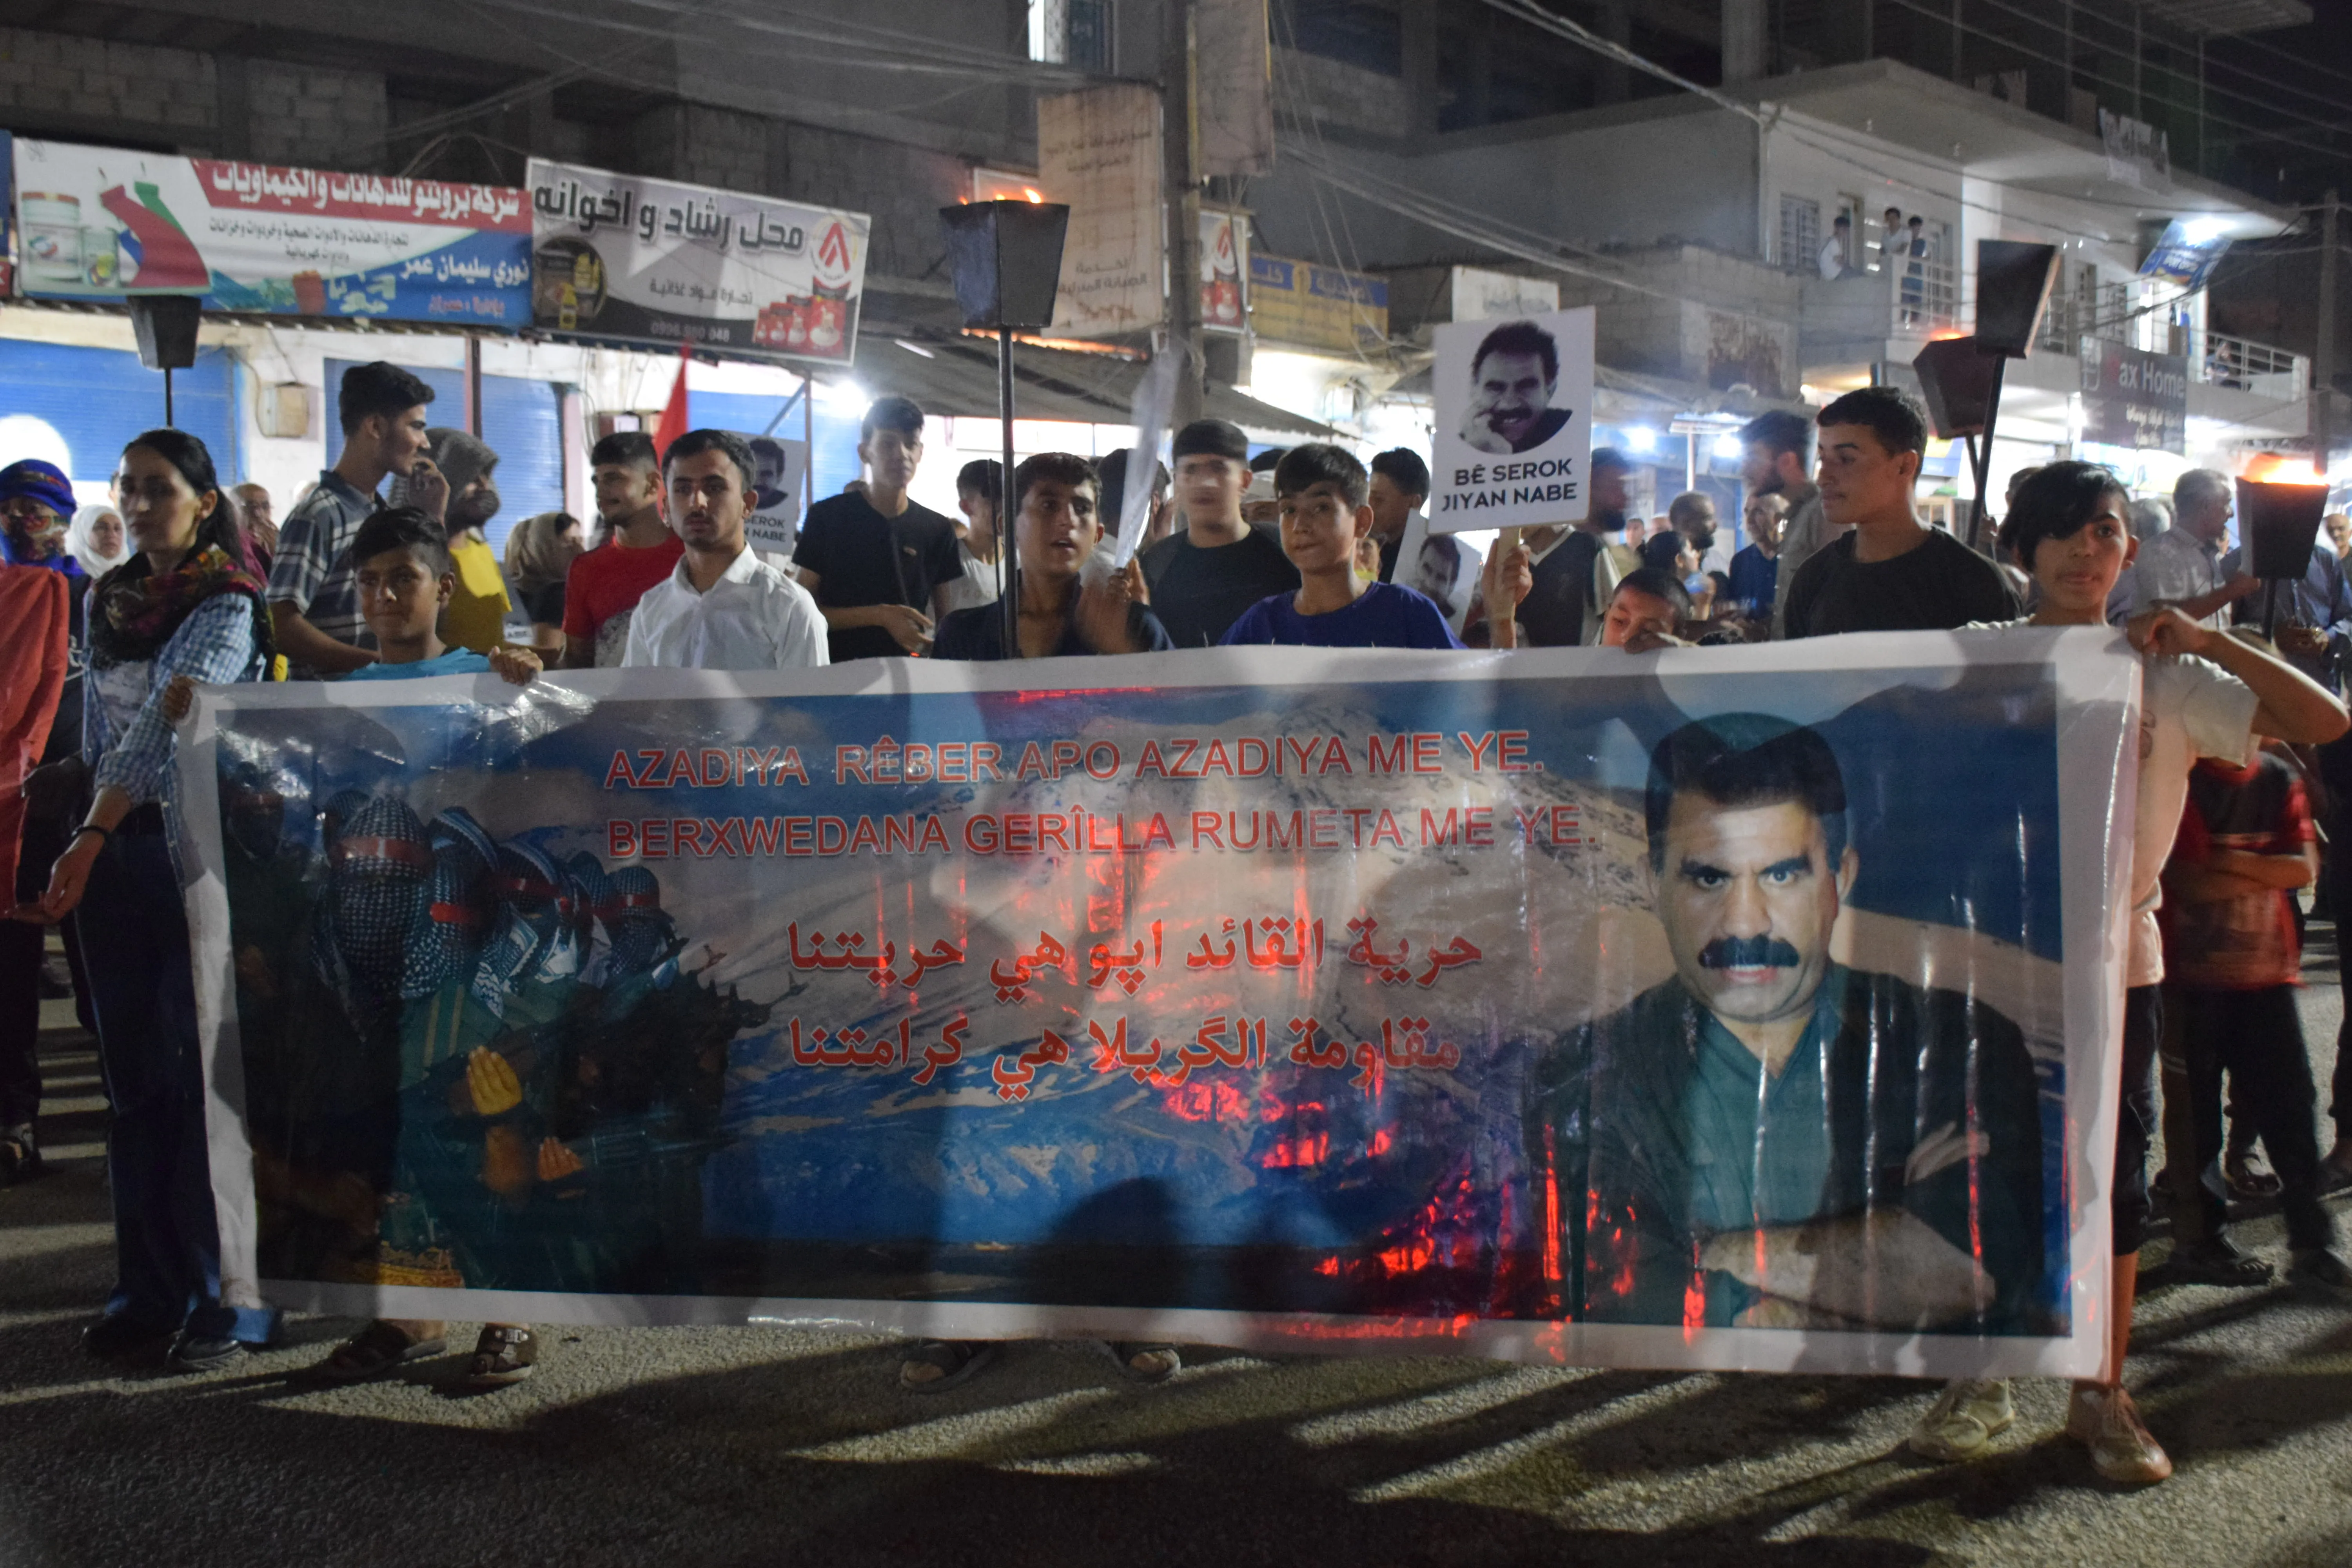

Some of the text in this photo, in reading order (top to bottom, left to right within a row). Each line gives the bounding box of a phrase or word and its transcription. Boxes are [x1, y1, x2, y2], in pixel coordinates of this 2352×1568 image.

[212, 162, 328, 209] والكيماويات
[331, 172, 412, 207] للدهانات
[472, 183, 519, 224] شركة
[534, 182, 804, 250] محل رشاد و اخوانه
[400, 257, 433, 280] عمر
[437, 254, 491, 284] سليمان
[2142, 359, 2185, 398] Home
[1441, 483, 1577, 512] JIYAN NABE
[1455, 458, 1572, 486] BÊ SEROK
[753, 528, 786, 542] NABE
[605, 730, 1544, 788] AZADIYA RÊBER APO AZADIYA ME YE.
[608, 813, 951, 858] BERXWEDANA
[964, 804, 1176, 855] GERÎLLA
[1191, 808, 1404, 851] RUMETA
[1420, 806, 1495, 848] ME
[787, 920, 966, 988] حريتنا
[989, 930, 1066, 1003] هي
[1185, 916, 1325, 969] القائد
[1347, 916, 1483, 987] حرية
[788, 1016, 969, 1086] كرامتنا
[992, 1028, 1070, 1102] هي
[1289, 1016, 1461, 1089] مقاومة
